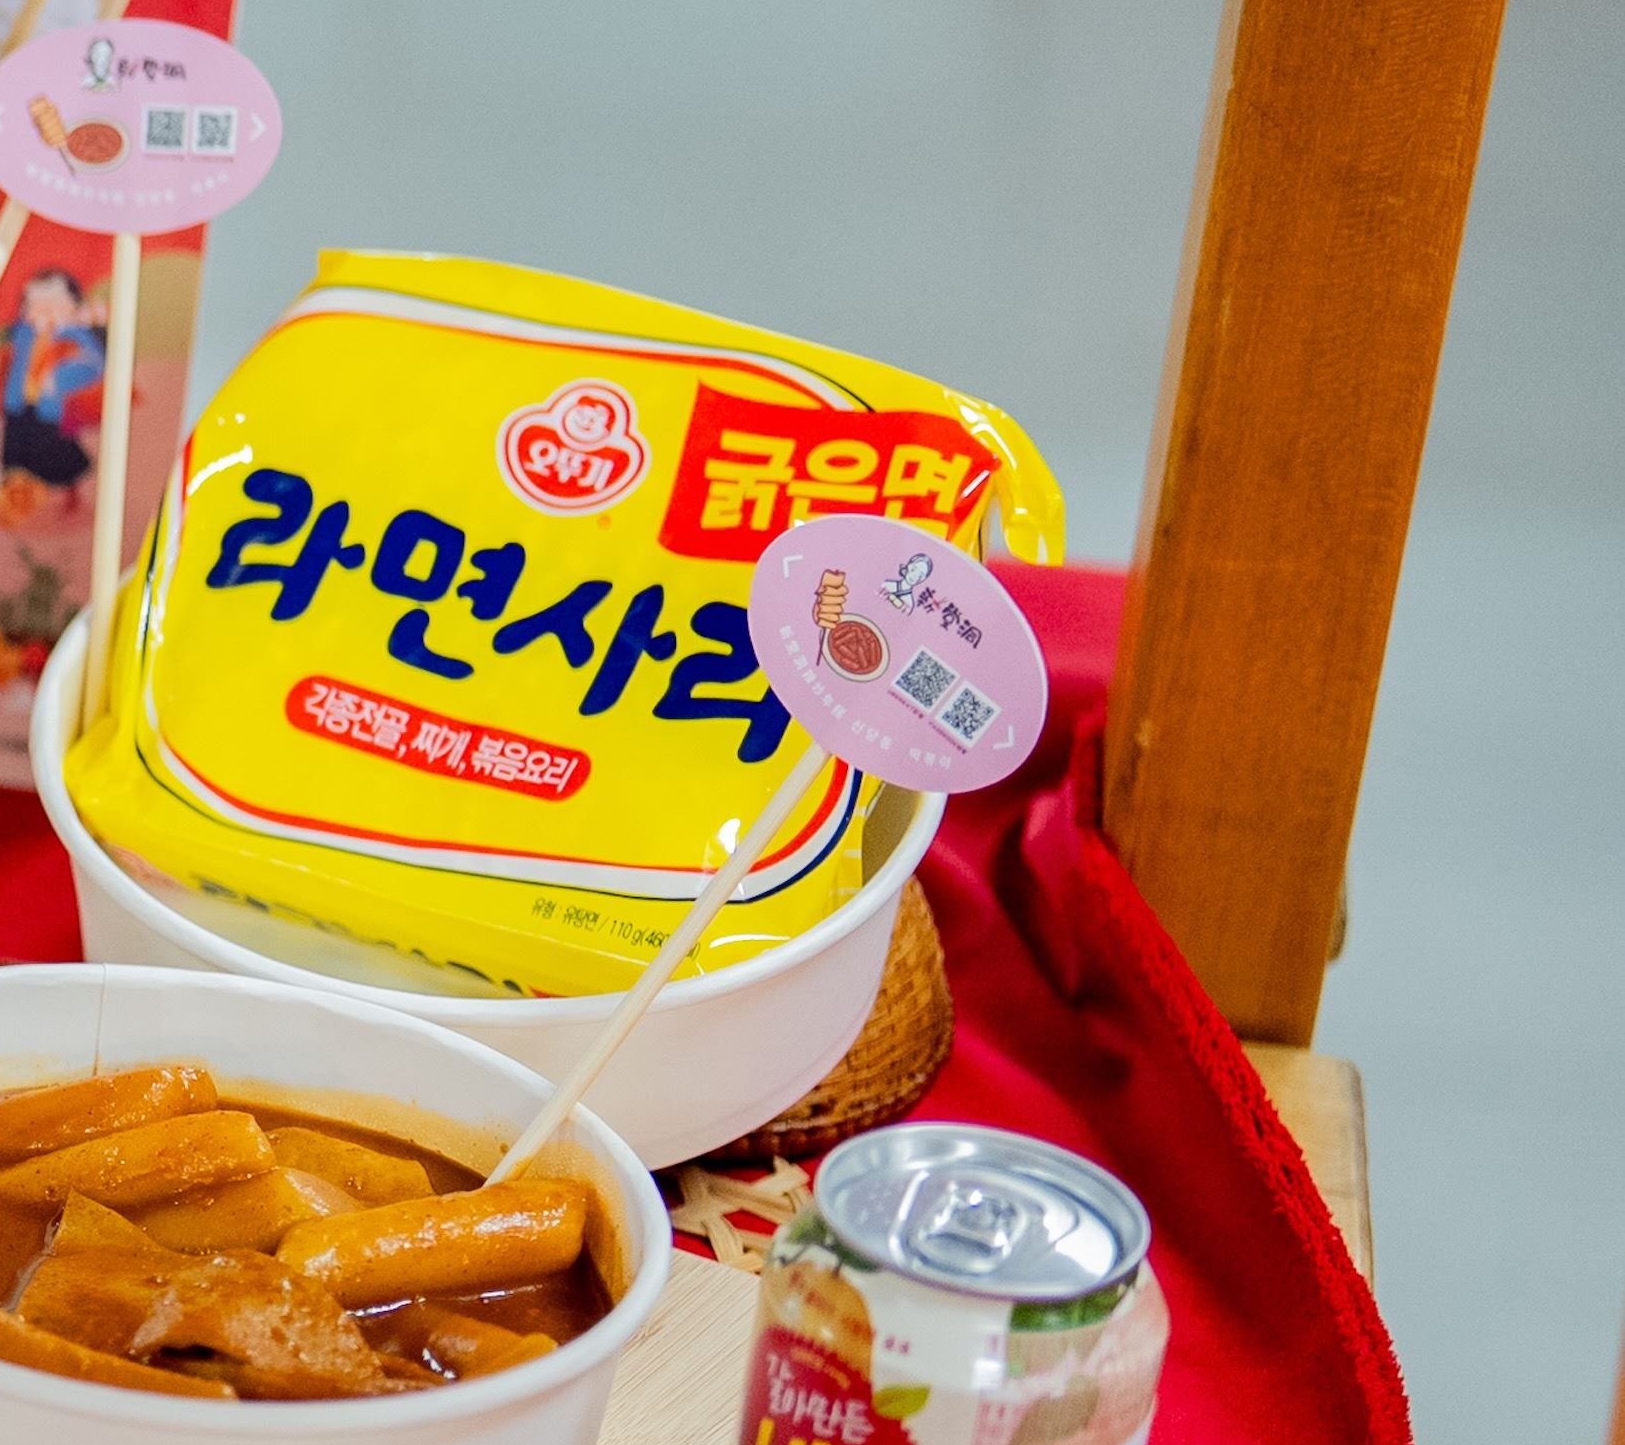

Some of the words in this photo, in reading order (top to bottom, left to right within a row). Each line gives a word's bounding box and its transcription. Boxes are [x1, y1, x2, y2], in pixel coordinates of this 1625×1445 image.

[528, 438, 616, 492] 오뚜기
[699, 428, 974, 541] 굵은면
[304, 683, 411, 759] 각종전골,
[411, 721, 472, 775] 찌개,
[472, 736, 579, 794] 볶음요리
